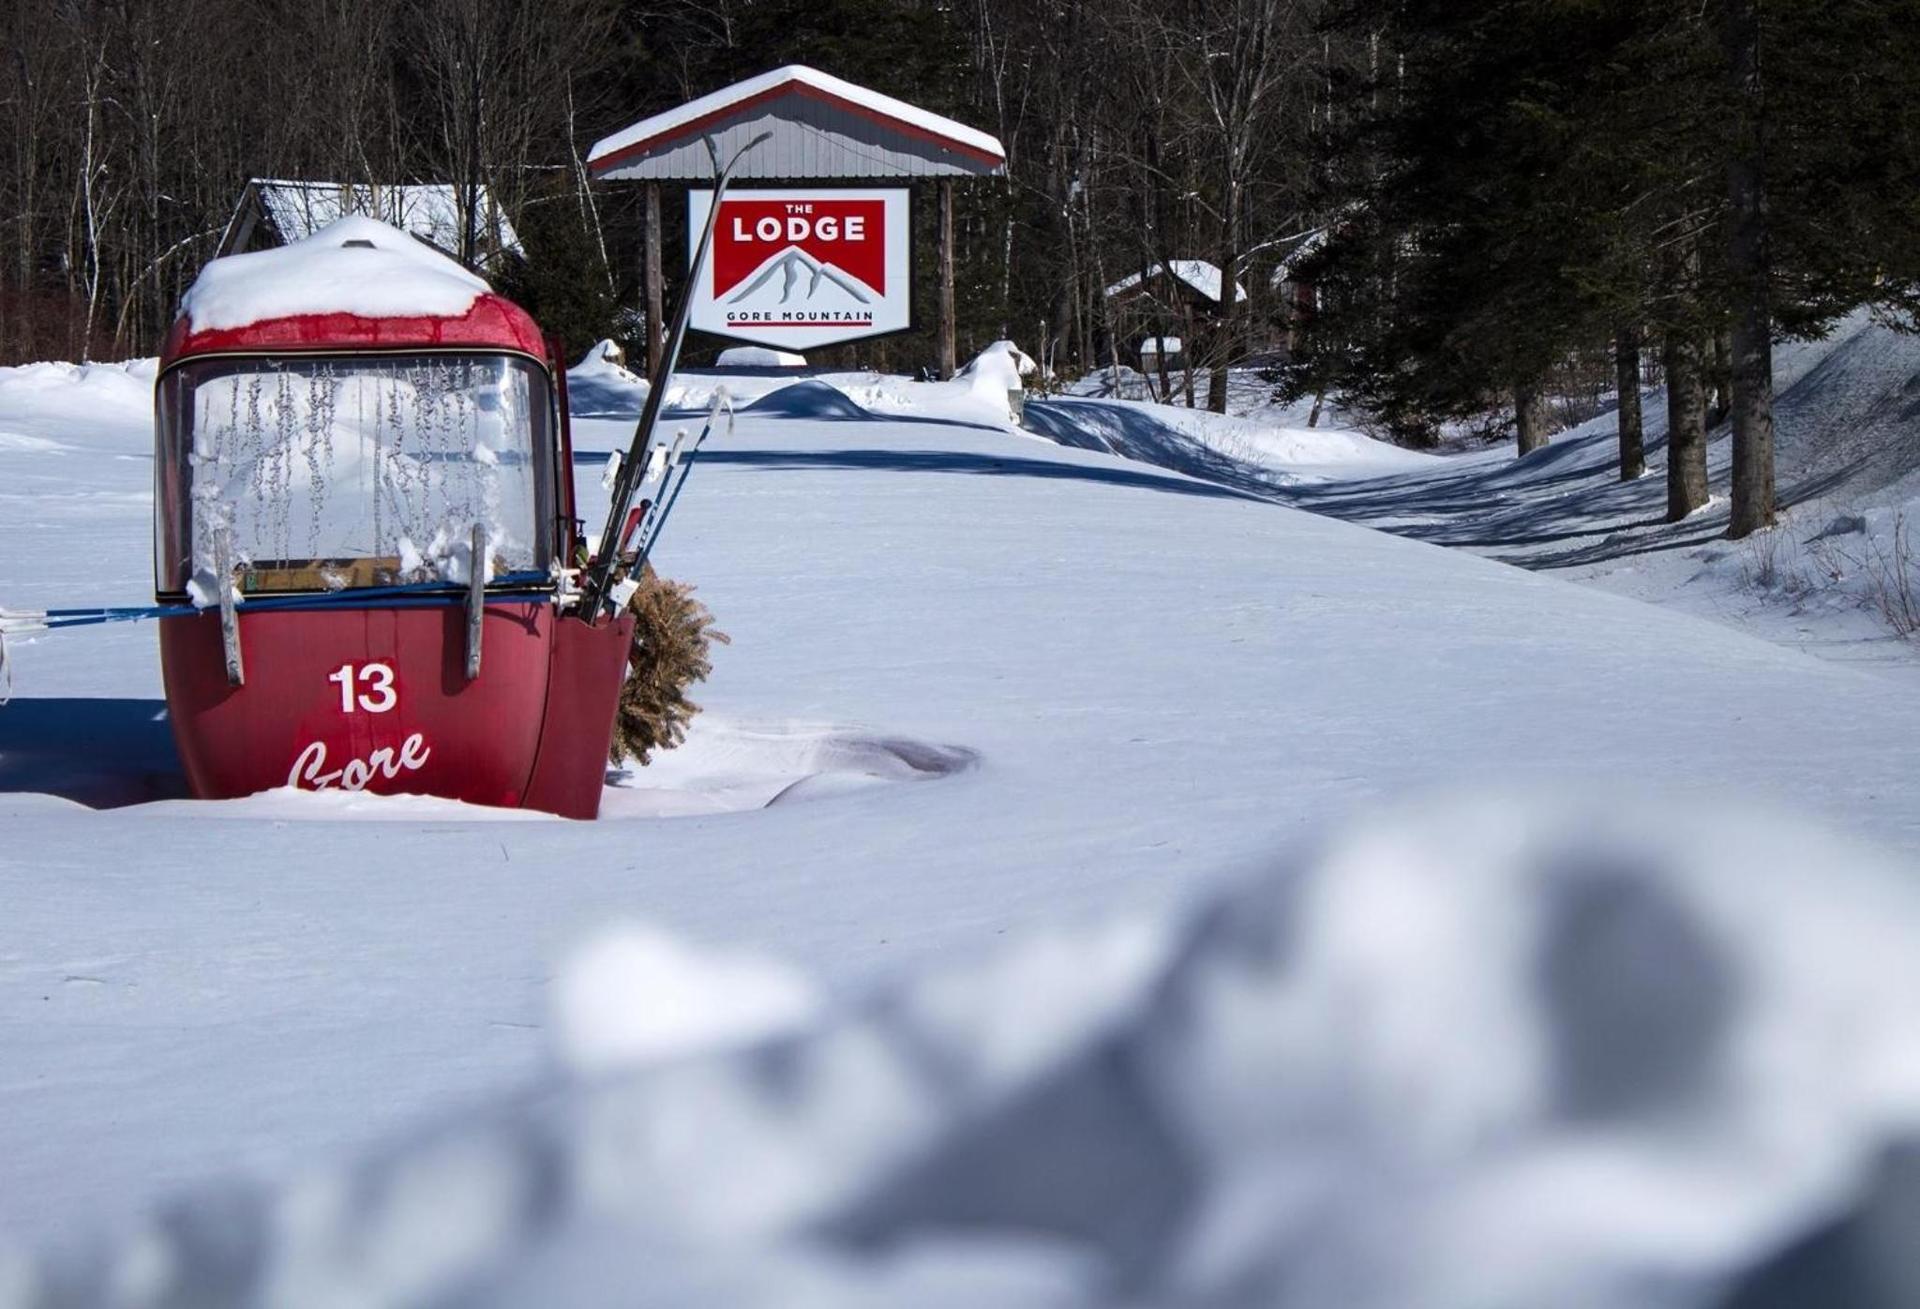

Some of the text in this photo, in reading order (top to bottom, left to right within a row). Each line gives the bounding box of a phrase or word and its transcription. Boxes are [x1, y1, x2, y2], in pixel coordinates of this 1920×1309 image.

[785, 204, 813, 214] THE
[733, 216, 865, 242] LODGE
[727, 311, 873, 321] GORE MOUNTAIN
[329, 663, 397, 713] 13
[287, 733, 430, 791] Gore
